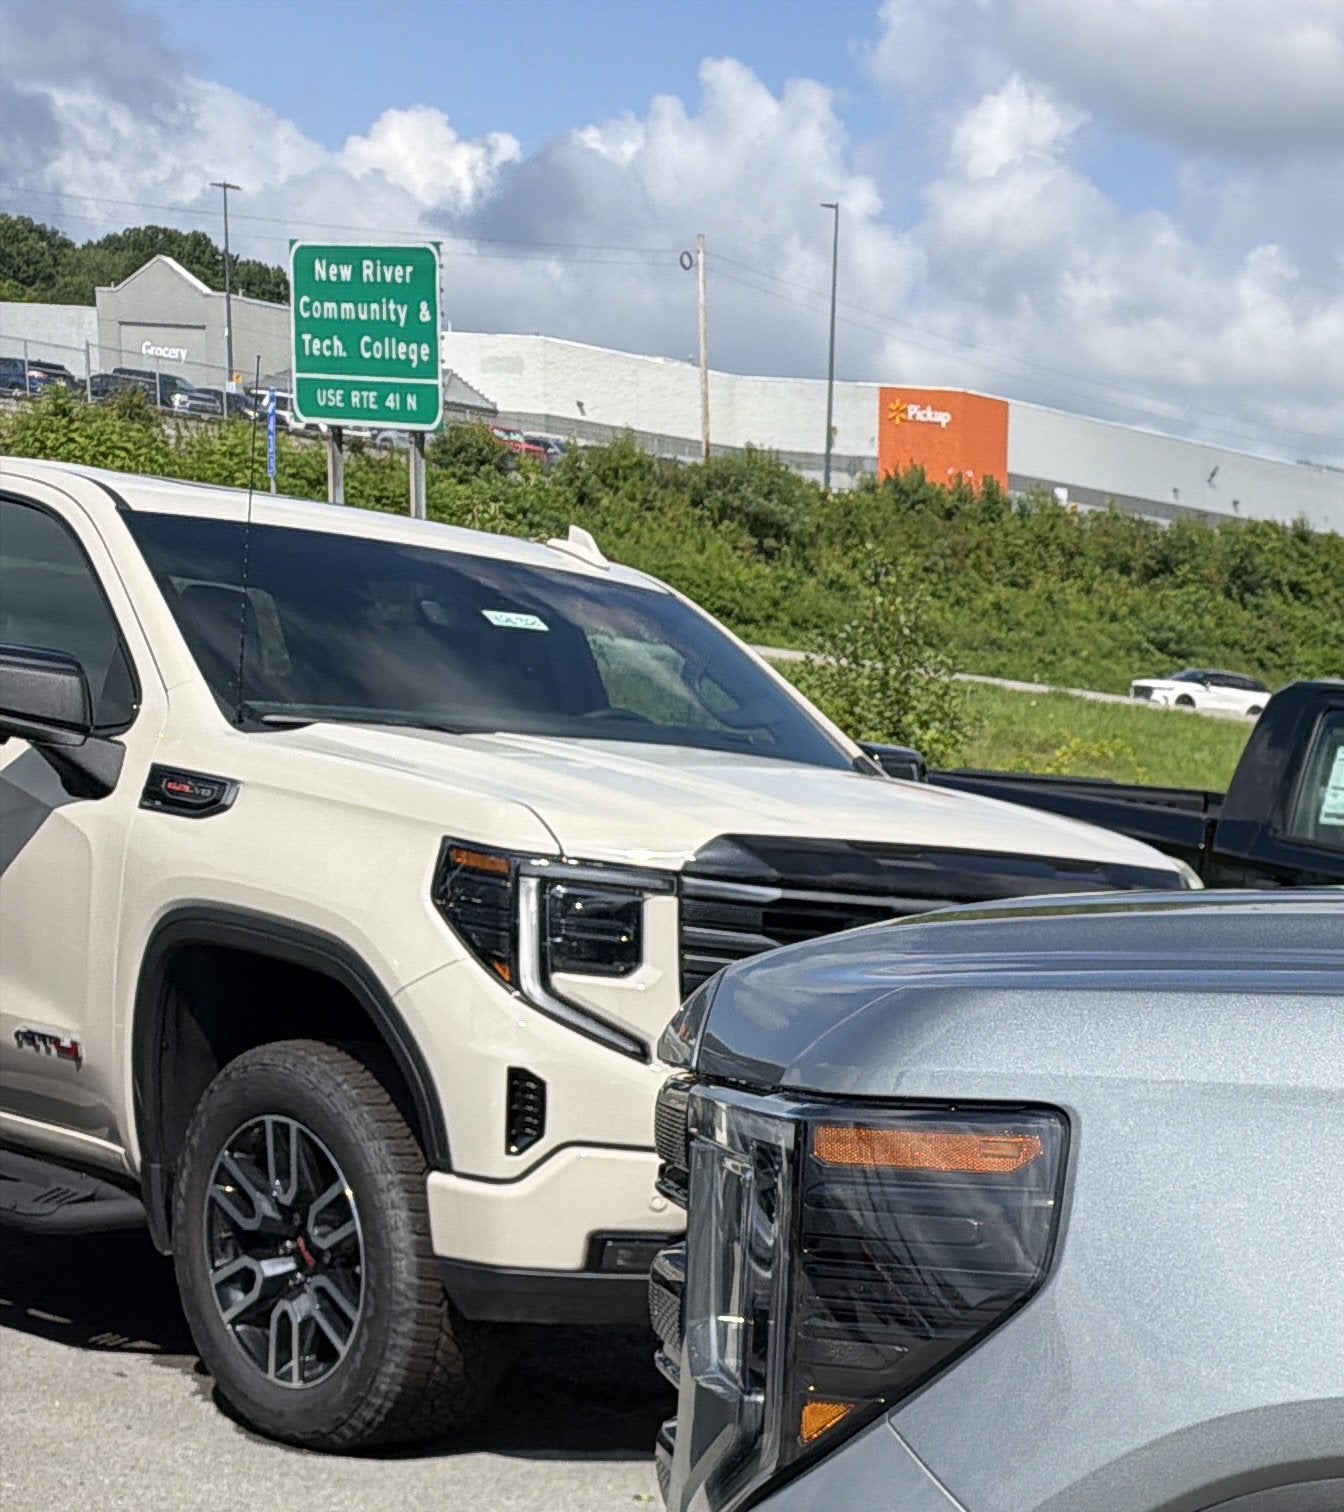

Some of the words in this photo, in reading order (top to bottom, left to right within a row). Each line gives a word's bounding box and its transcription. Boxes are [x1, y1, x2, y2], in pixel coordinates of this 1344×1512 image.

[314, 257, 352, 282] New
[362, 259, 414, 283] River
[299, 295, 408, 328] Community
[418, 300, 432, 323] &
[141, 341, 188, 364] Grocery
[301, 333, 347, 358] Tech.
[360, 335, 430, 368] College
[316, 388, 344, 408] USE
[351, 390, 378, 410] RTE
[384, 392, 400, 411] 41
[406, 393, 418, 412] N
[907, 403, 952, 428] Pickup
